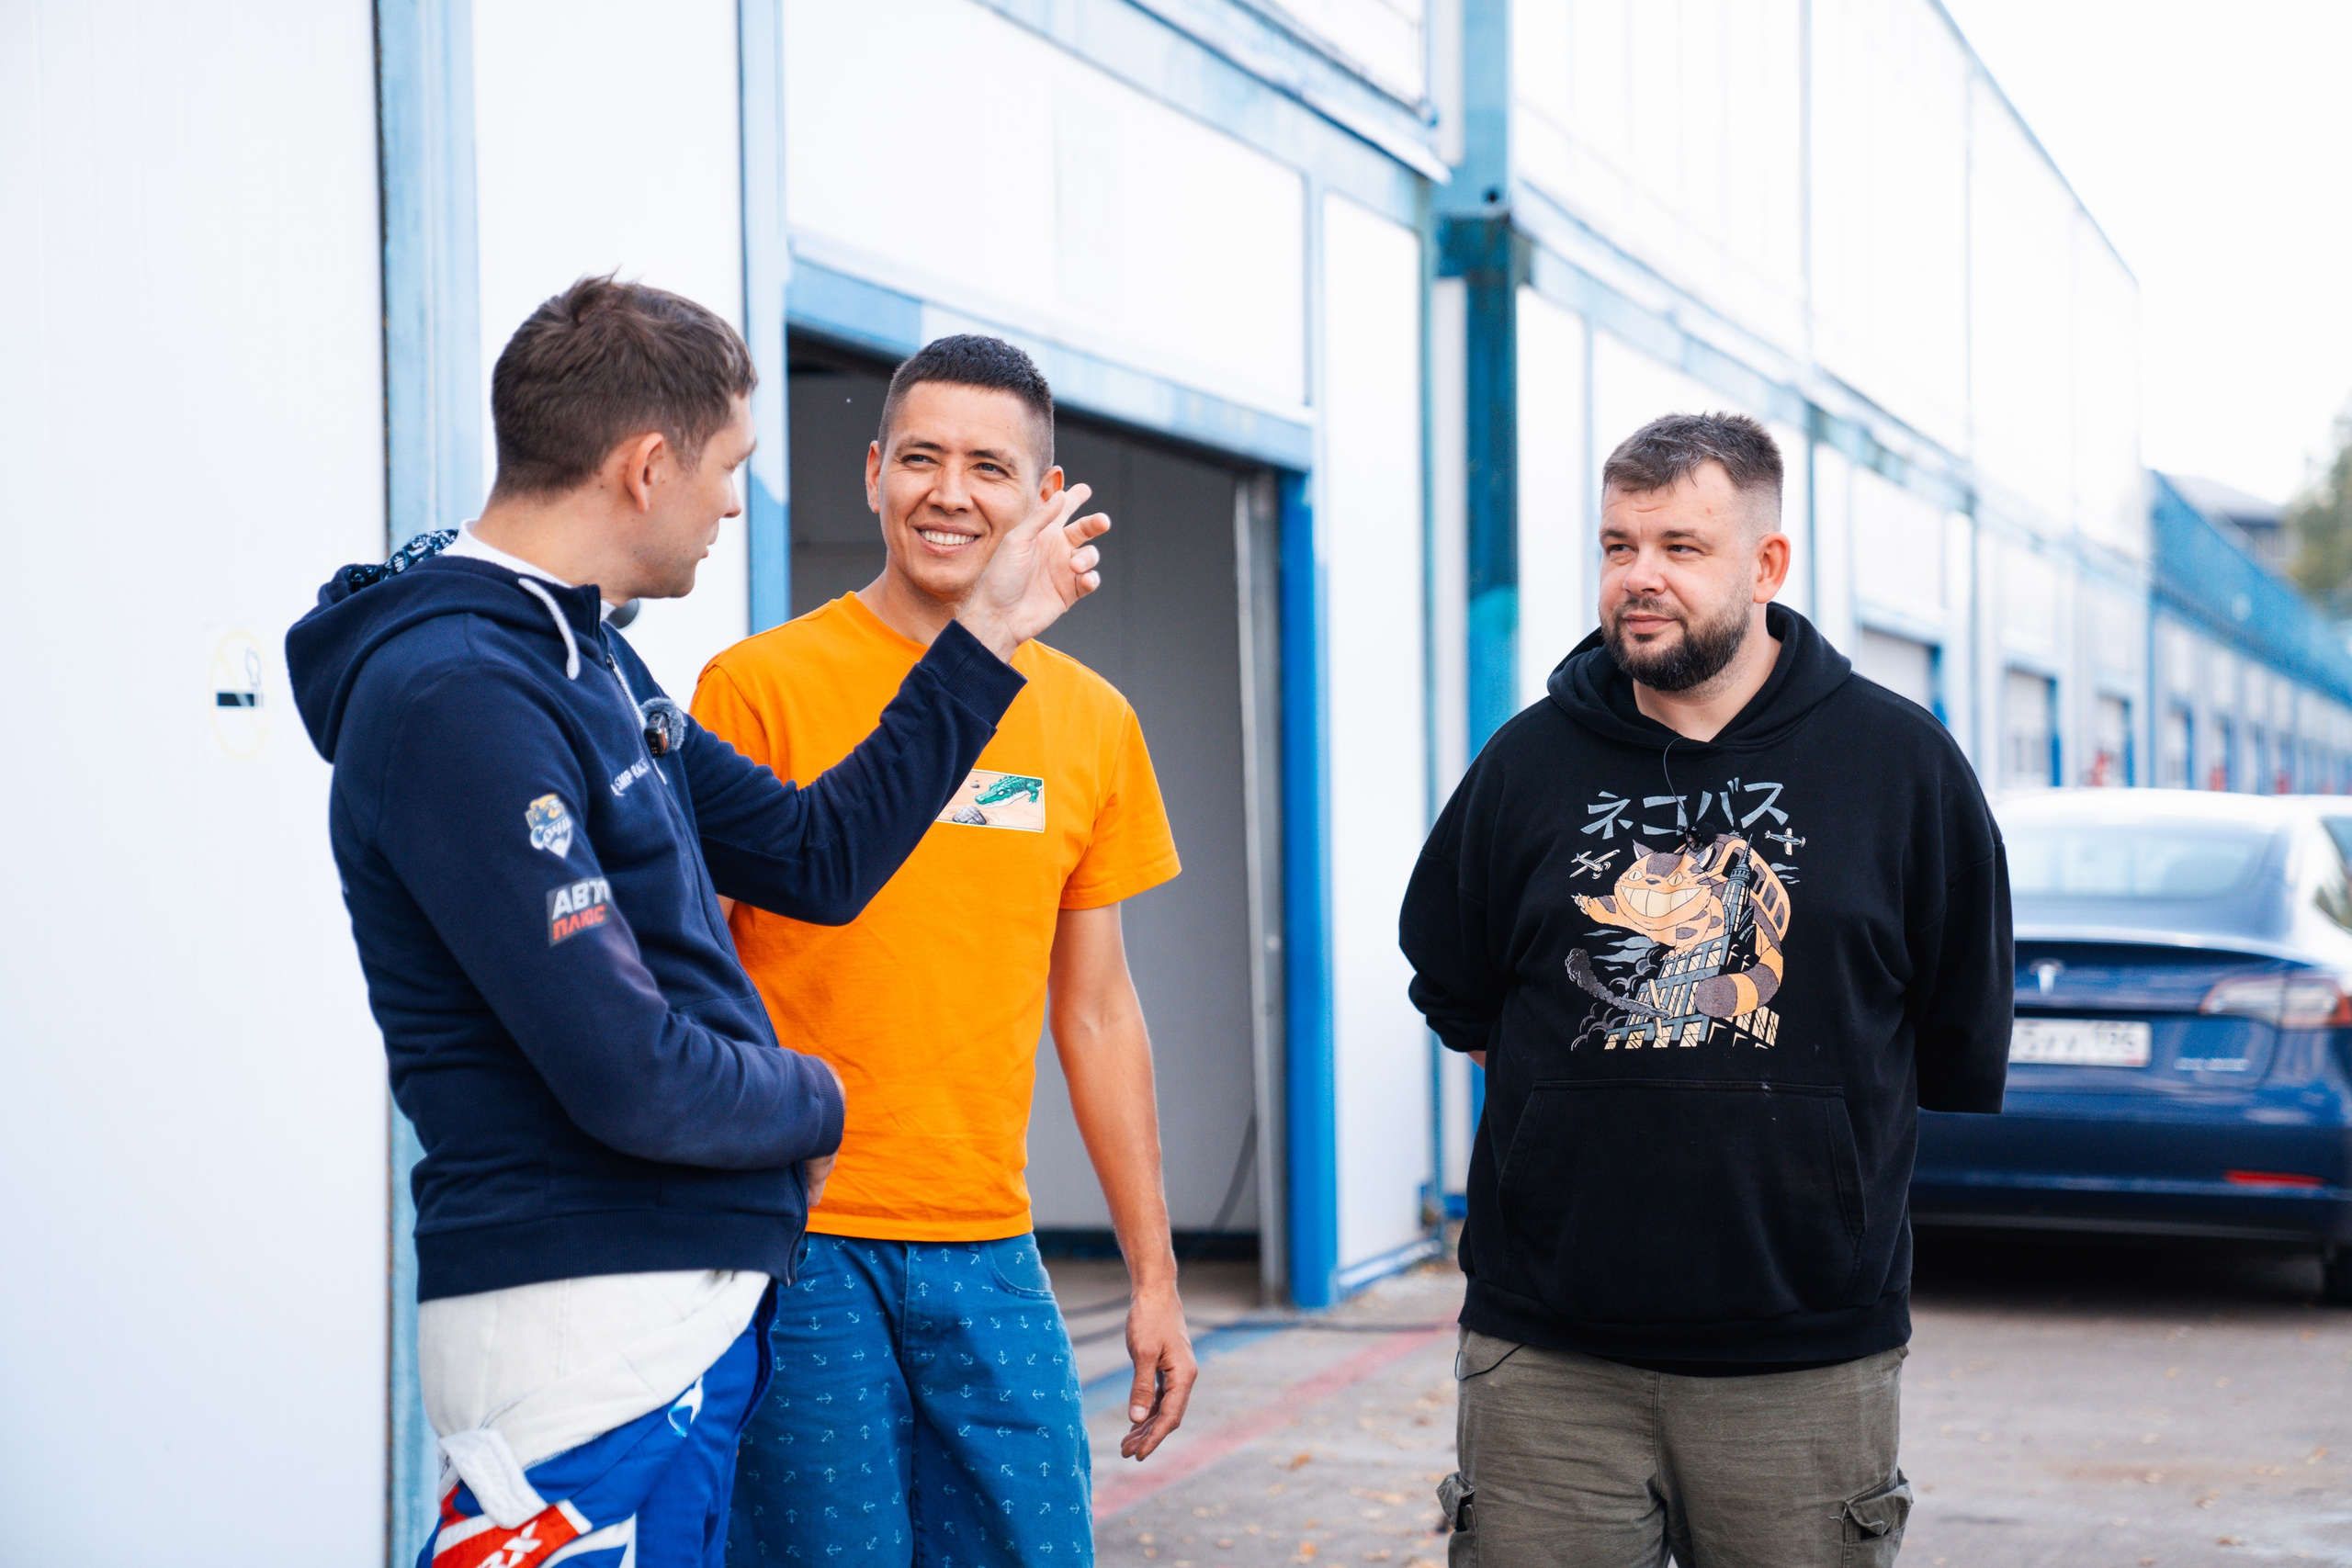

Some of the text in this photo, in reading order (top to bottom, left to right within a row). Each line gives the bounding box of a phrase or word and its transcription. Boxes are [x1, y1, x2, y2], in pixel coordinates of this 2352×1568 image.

[1580, 777, 1789, 840] ネコバス
[553, 904, 606, 941] ПЛЮС
